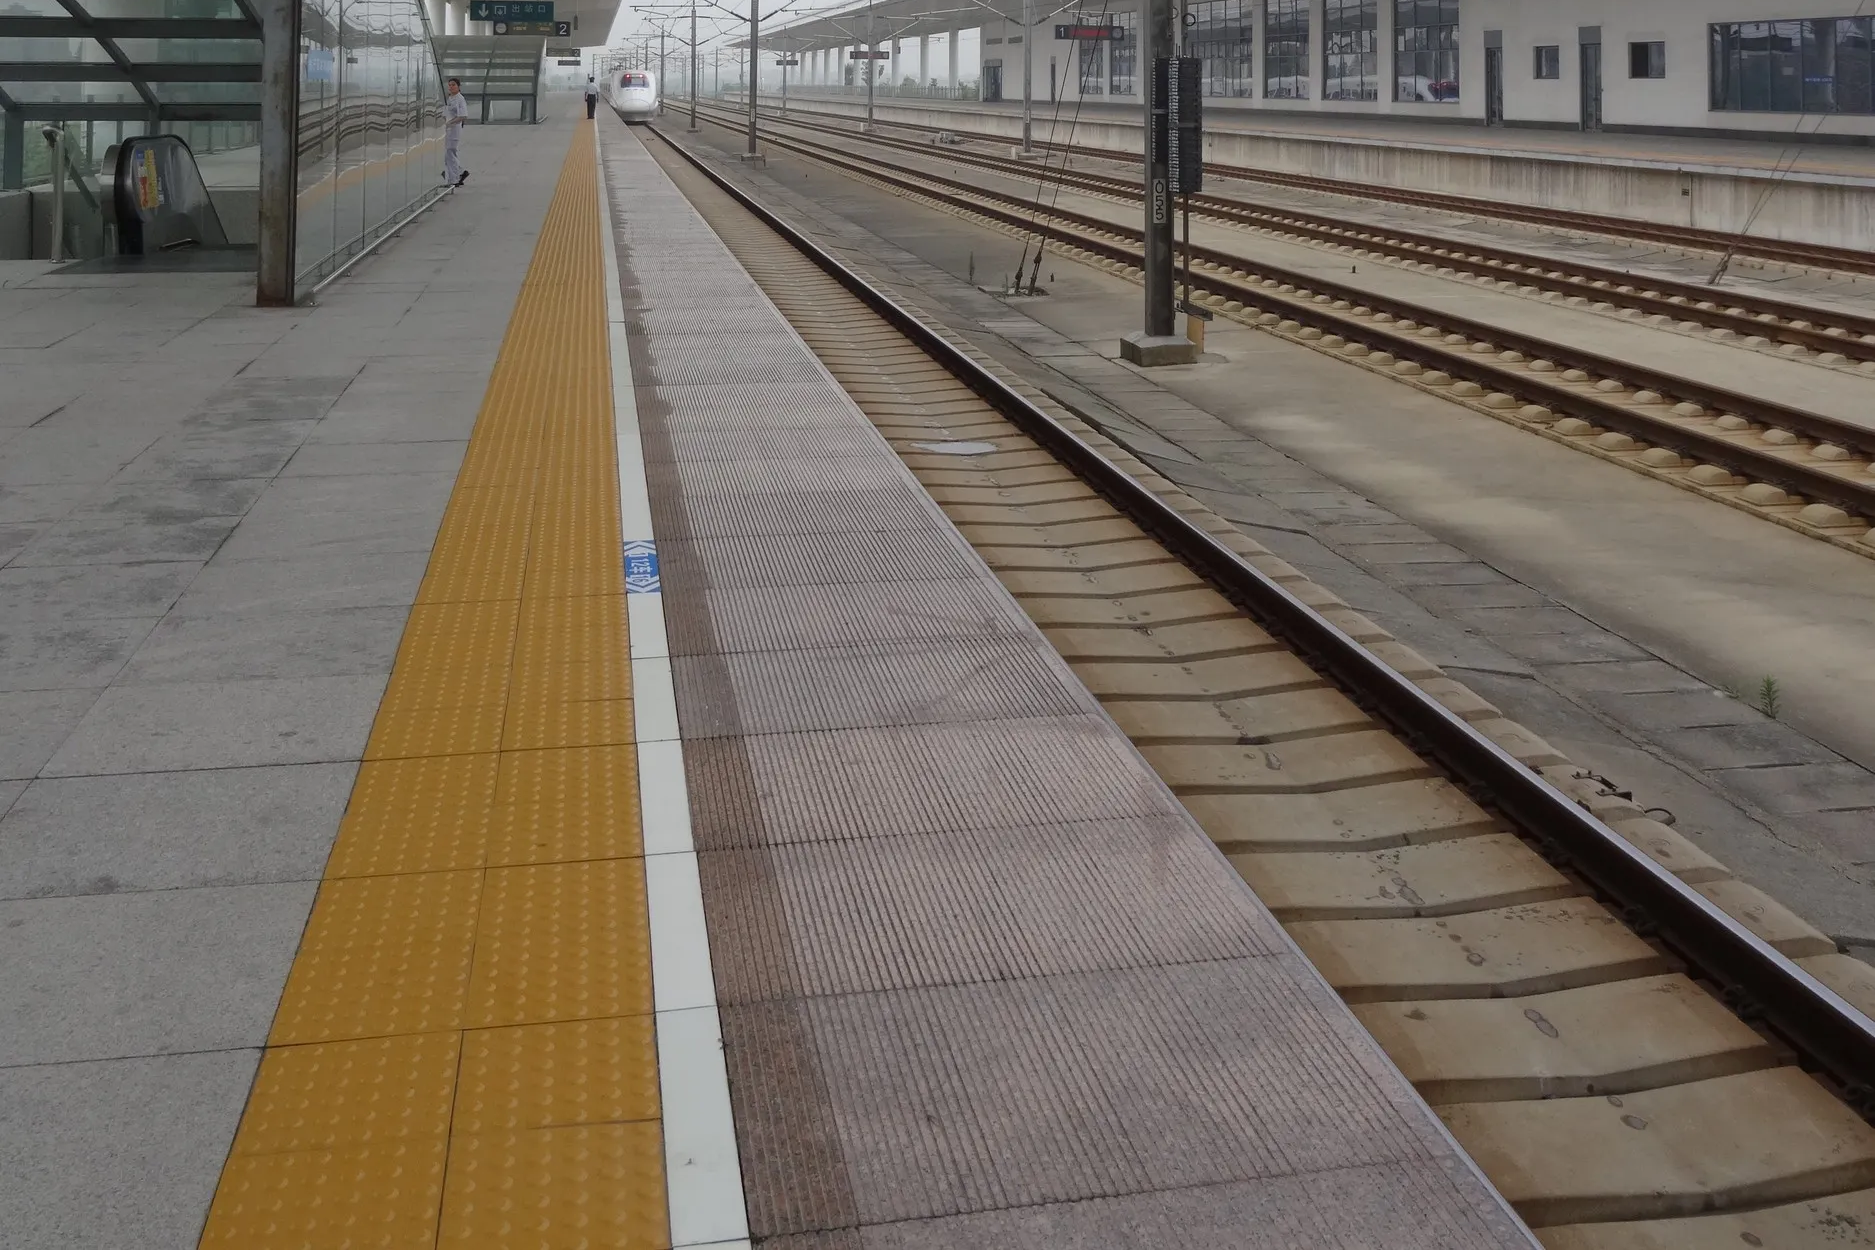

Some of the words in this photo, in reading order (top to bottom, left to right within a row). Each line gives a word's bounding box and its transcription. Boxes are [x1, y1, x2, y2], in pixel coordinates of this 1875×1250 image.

[511, 4, 546, 13] 出站口
[559, 23, 567, 35] 2
[1059, 27, 1064, 38] 1
[1155, 182, 1164, 220] 055
